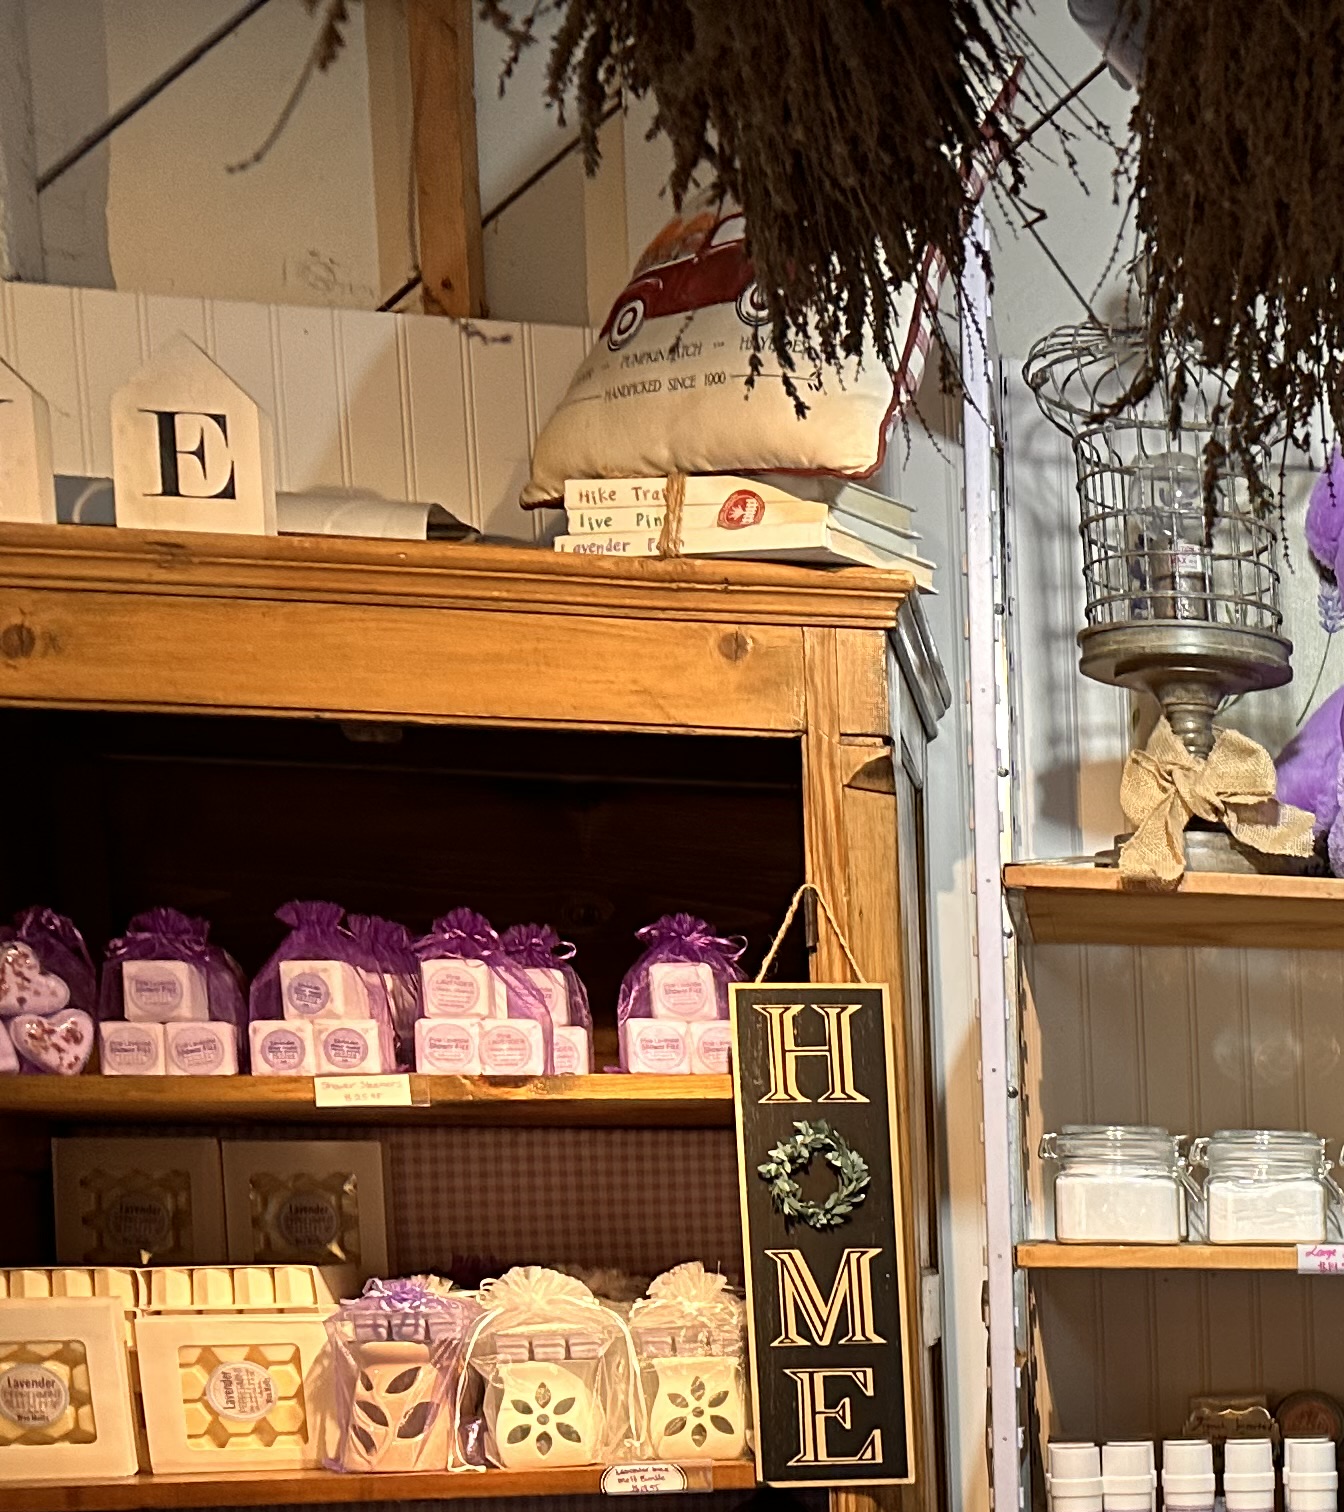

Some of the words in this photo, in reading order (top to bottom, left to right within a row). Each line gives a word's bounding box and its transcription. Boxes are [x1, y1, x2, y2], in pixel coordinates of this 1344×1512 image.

[667, 374, 697, 392] SINCE
[703, 372, 727, 387] 1900
[141, 409, 236, 500] E
[579, 488, 617, 504] Hike
[635, 512, 665, 528] Pin
[7, 1376, 56, 1389] Lavender
